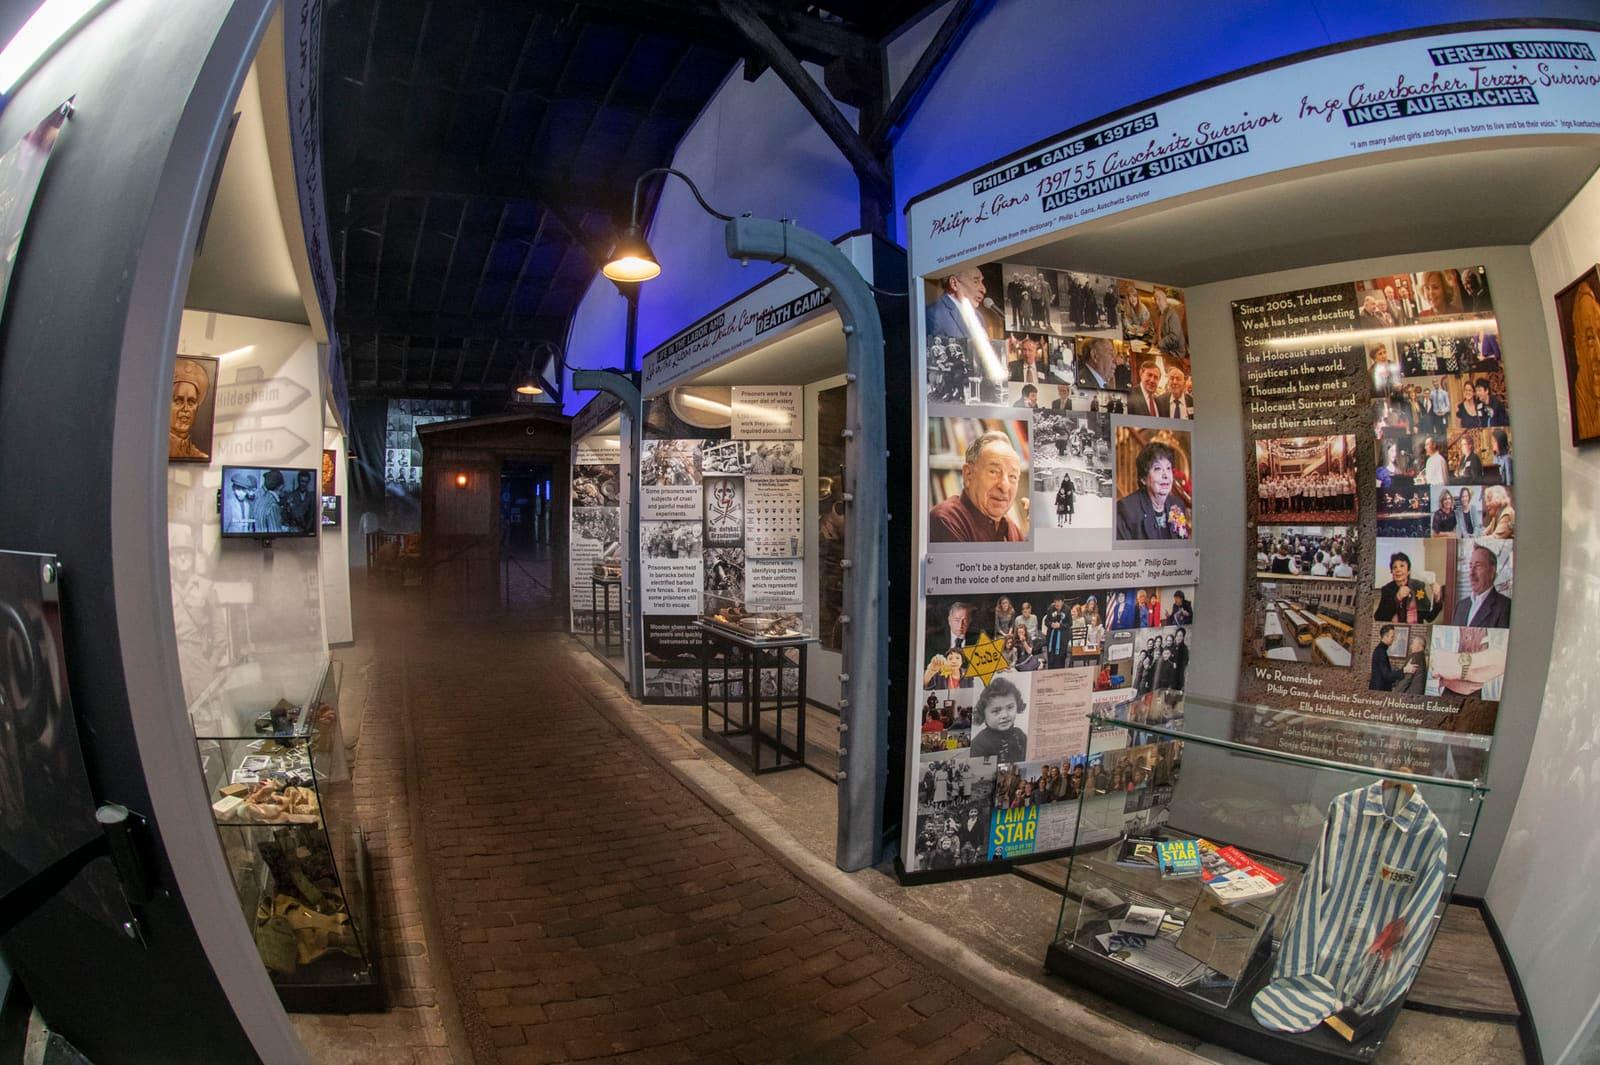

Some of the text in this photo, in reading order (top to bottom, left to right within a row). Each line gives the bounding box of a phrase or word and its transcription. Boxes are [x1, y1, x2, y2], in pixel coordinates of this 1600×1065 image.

[1432, 42, 1594, 65] TEREZIN SURVIVOR
[1299, 95, 1343, 122] Inge
[1469, 64, 1537, 91] Terezin
[1348, 87, 1537, 125] INGE AUERBACHER
[1357, 140, 1368, 148] am
[1369, 137, 1386, 146] many
[1388, 133, 1406, 143] silent
[1407, 130, 1421, 142] girls
[1423, 128, 1435, 138] and
[1436, 126, 1454, 138] boys,
[1458, 124, 1471, 133] was
[1471, 122, 1486, 132] born
[1486, 121, 1493, 131] to
[1493, 120, 1505, 130] live
[1506, 120, 1516, 129] and
[1517, 120, 1525, 129] be
[1526, 119, 1539, 128] their
[974, 115, 1156, 193] PHILIP L. GANS 139755
[929, 210, 972, 240] Philip
[991, 193, 1029, 218] Gans
[1036, 160, 1096, 197] 139755
[1102, 131, 1191, 175] Auschwitz
[1195, 112, 1282, 146] Survivor
[1044, 137, 1248, 212] AUSCHWITZ SURVIVOR
[1058, 212, 1074, 224] Philip
[1097, 197, 1125, 212] Auschwitz
[1126, 190, 1150, 203] Survivor
[1240, 293, 1343, 315] Since 2005, Tolerance
[757, 304, 791, 333] DEATH
[1242, 308, 1355, 330] Week has been educating
[675, 337, 687, 352] THE
[687, 323, 709, 345] LABOR
[709, 314, 724, 334] AND
[1246, 343, 1352, 364] the Holocaust and other
[1248, 358, 1346, 382] injustices in the world.
[216, 386, 279, 409] Hildesheim
[1248, 379, 1348, 396] Thousands have met a
[1251, 394, 1356, 413] Holocaust Survivor and
[1251, 416, 1336, 430] heard their stories.
[217, 435, 273, 457] Minden
[940, 577, 953, 585] am
[955, 576, 967, 584] the
[968, 575, 989, 584] voice
[991, 574, 999, 583] of
[1000, 575, 1013, 583] one
[1016, 574, 1029, 583] and
[1037, 573, 1051, 582] half
[1052, 572, 1075, 582] million
[1077, 571, 1095, 581] silent
[1096, 571, 1110, 581] girls
[1112, 571, 1124, 579] and
[1148, 570, 1160, 579] Inge
[1161, 569, 1193, 577] Auerbacher
[982, 563, 992, 571] be
[1000, 562, 1038, 573] bystander,
[1040, 561, 1060, 572] speak
[1062, 562, 1073, 571] up.
[1076, 560, 1095, 569] Never
[1097, 560, 1110, 571] give
[1112, 560, 1120, 570] up
[1144, 558, 1161, 568] Philip
[1162, 558, 1177, 566] Gans
[974, 651, 998, 667] Jude
[1256, 667, 1322, 686] We Remember
[1267, 683, 1459, 714] Philip Gans, Auschwitz Survivor/Holocaust Educator
[1300, 701, 1313, 712] Ella
[1347, 708, 1361, 718] Art
[1363, 709, 1393, 722] Contest
[1395, 713, 1424, 725] Winner
[996, 804, 1037, 825] I AM A
[994, 821, 1036, 846] STAR
[1162, 850, 1197, 861] STAR
[1168, 841, 1184, 852] AM
[1187, 841, 1194, 850] A
